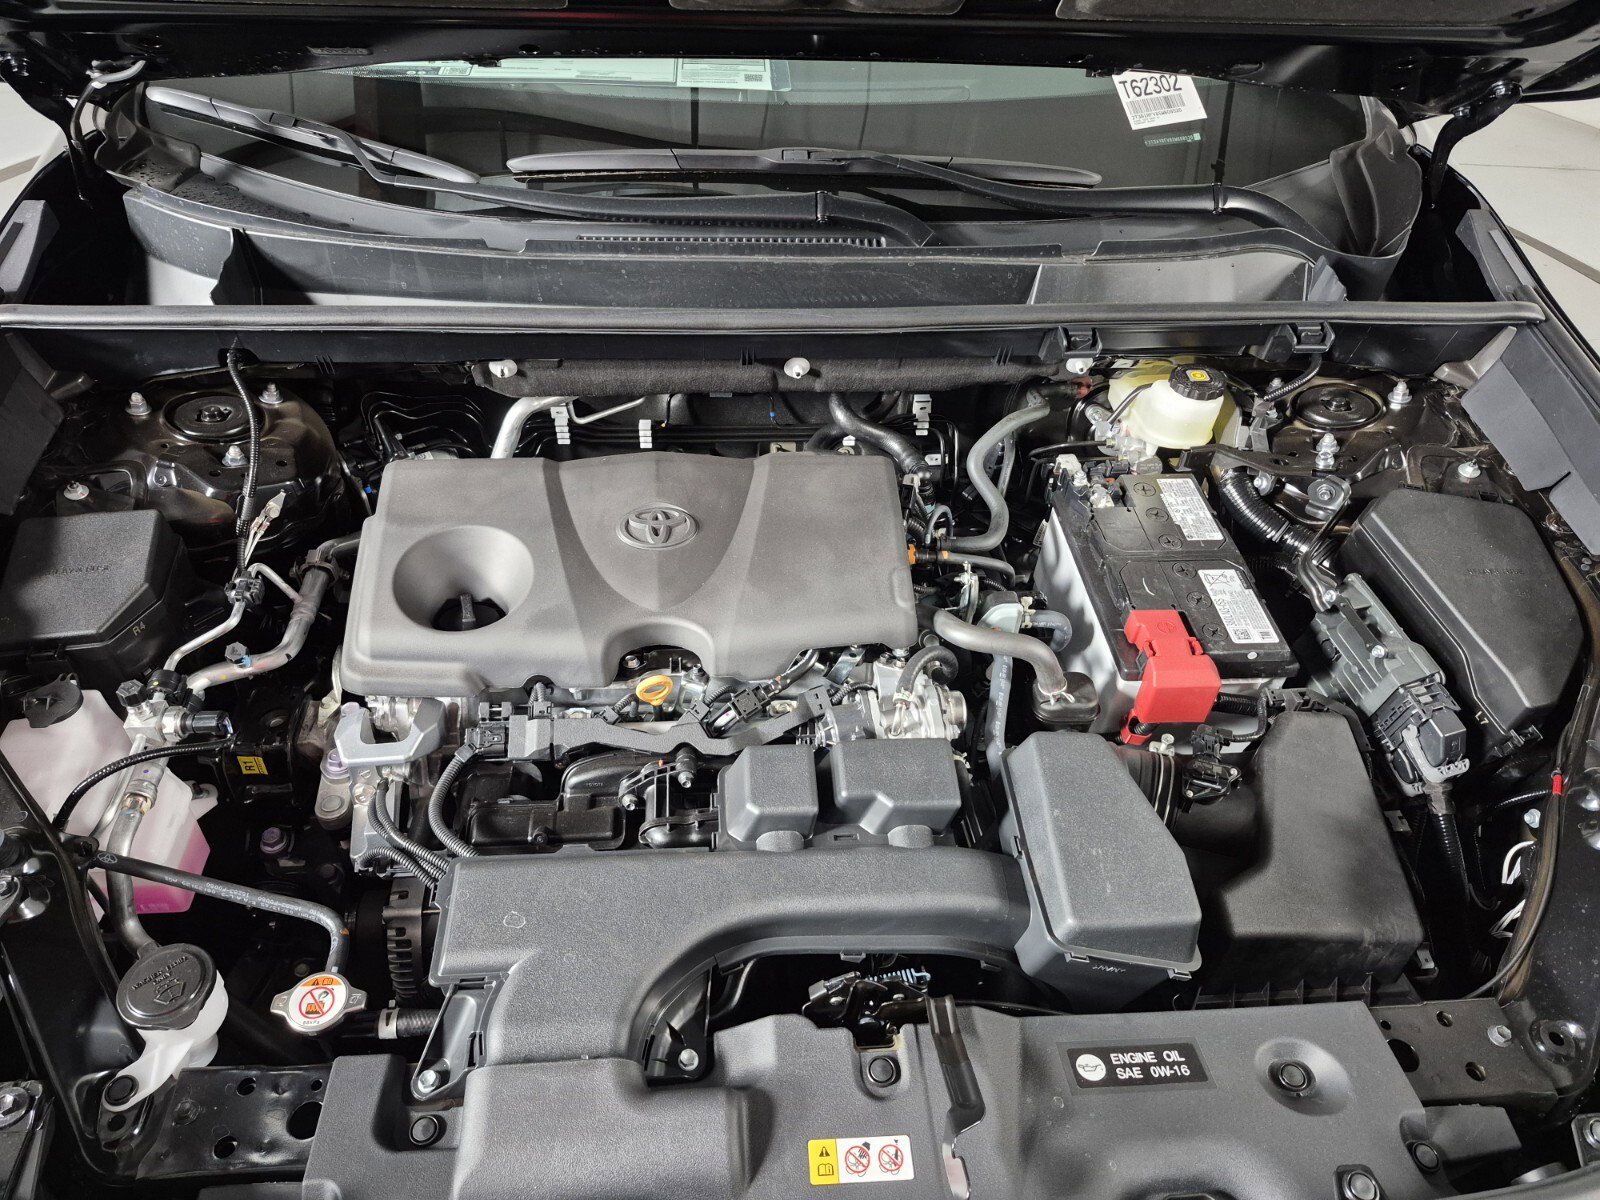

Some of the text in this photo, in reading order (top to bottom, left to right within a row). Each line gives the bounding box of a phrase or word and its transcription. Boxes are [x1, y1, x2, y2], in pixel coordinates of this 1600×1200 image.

[1119, 74, 1182, 98] T62302
[132, 621, 146, 636] R4
[1474, 711, 1489, 727] L7
[243, 761, 255, 772] R1
[1110, 1050, 1185, 1064] ENGINE OIL
[1116, 1065, 1190, 1079] SAE 0W-16
